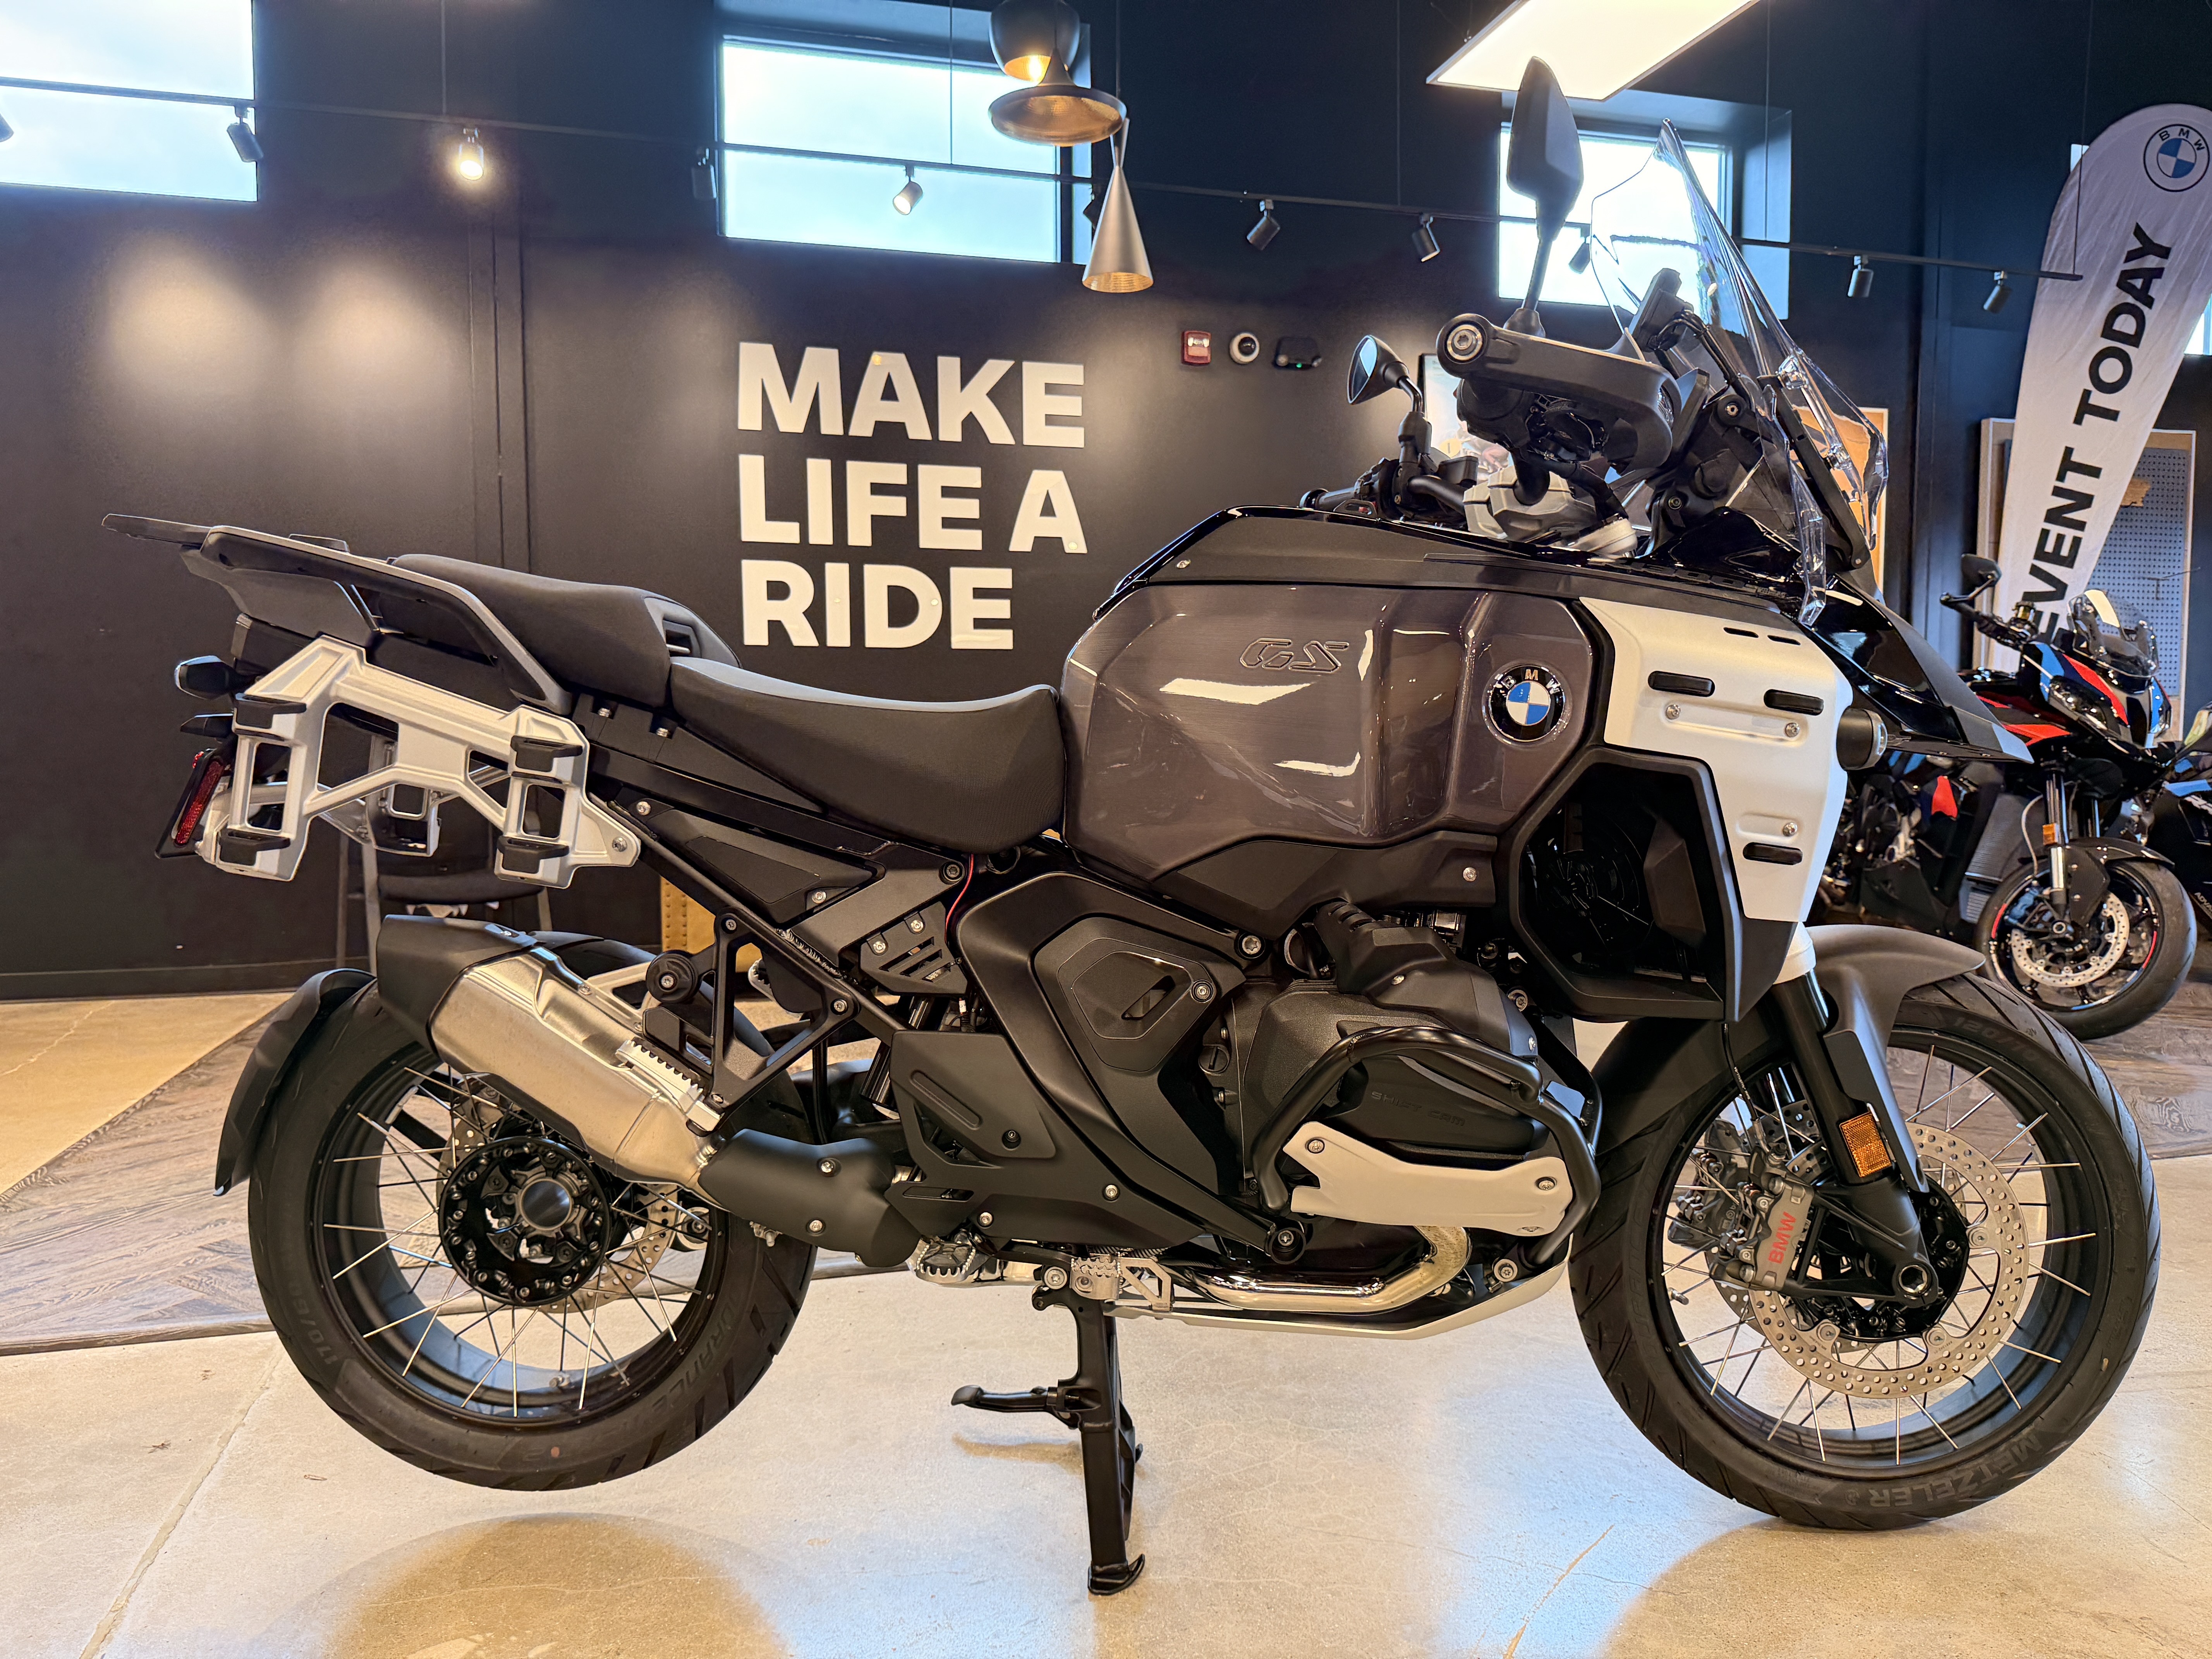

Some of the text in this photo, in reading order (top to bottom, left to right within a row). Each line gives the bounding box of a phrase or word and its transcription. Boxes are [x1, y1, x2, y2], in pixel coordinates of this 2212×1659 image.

[2073, 222, 2172, 426] TODAY
[738, 342, 1085, 448] MAKE
[738, 454, 1087, 553] LIFE A
[741, 559, 1013, 649] RIDE
[1239, 637, 1350, 673] GS
[1371, 1090, 1466, 1126] SHIFT CAM
[1768, 1212, 1797, 1264] BMW
[1869, 1434, 2043, 1508] METZELER
